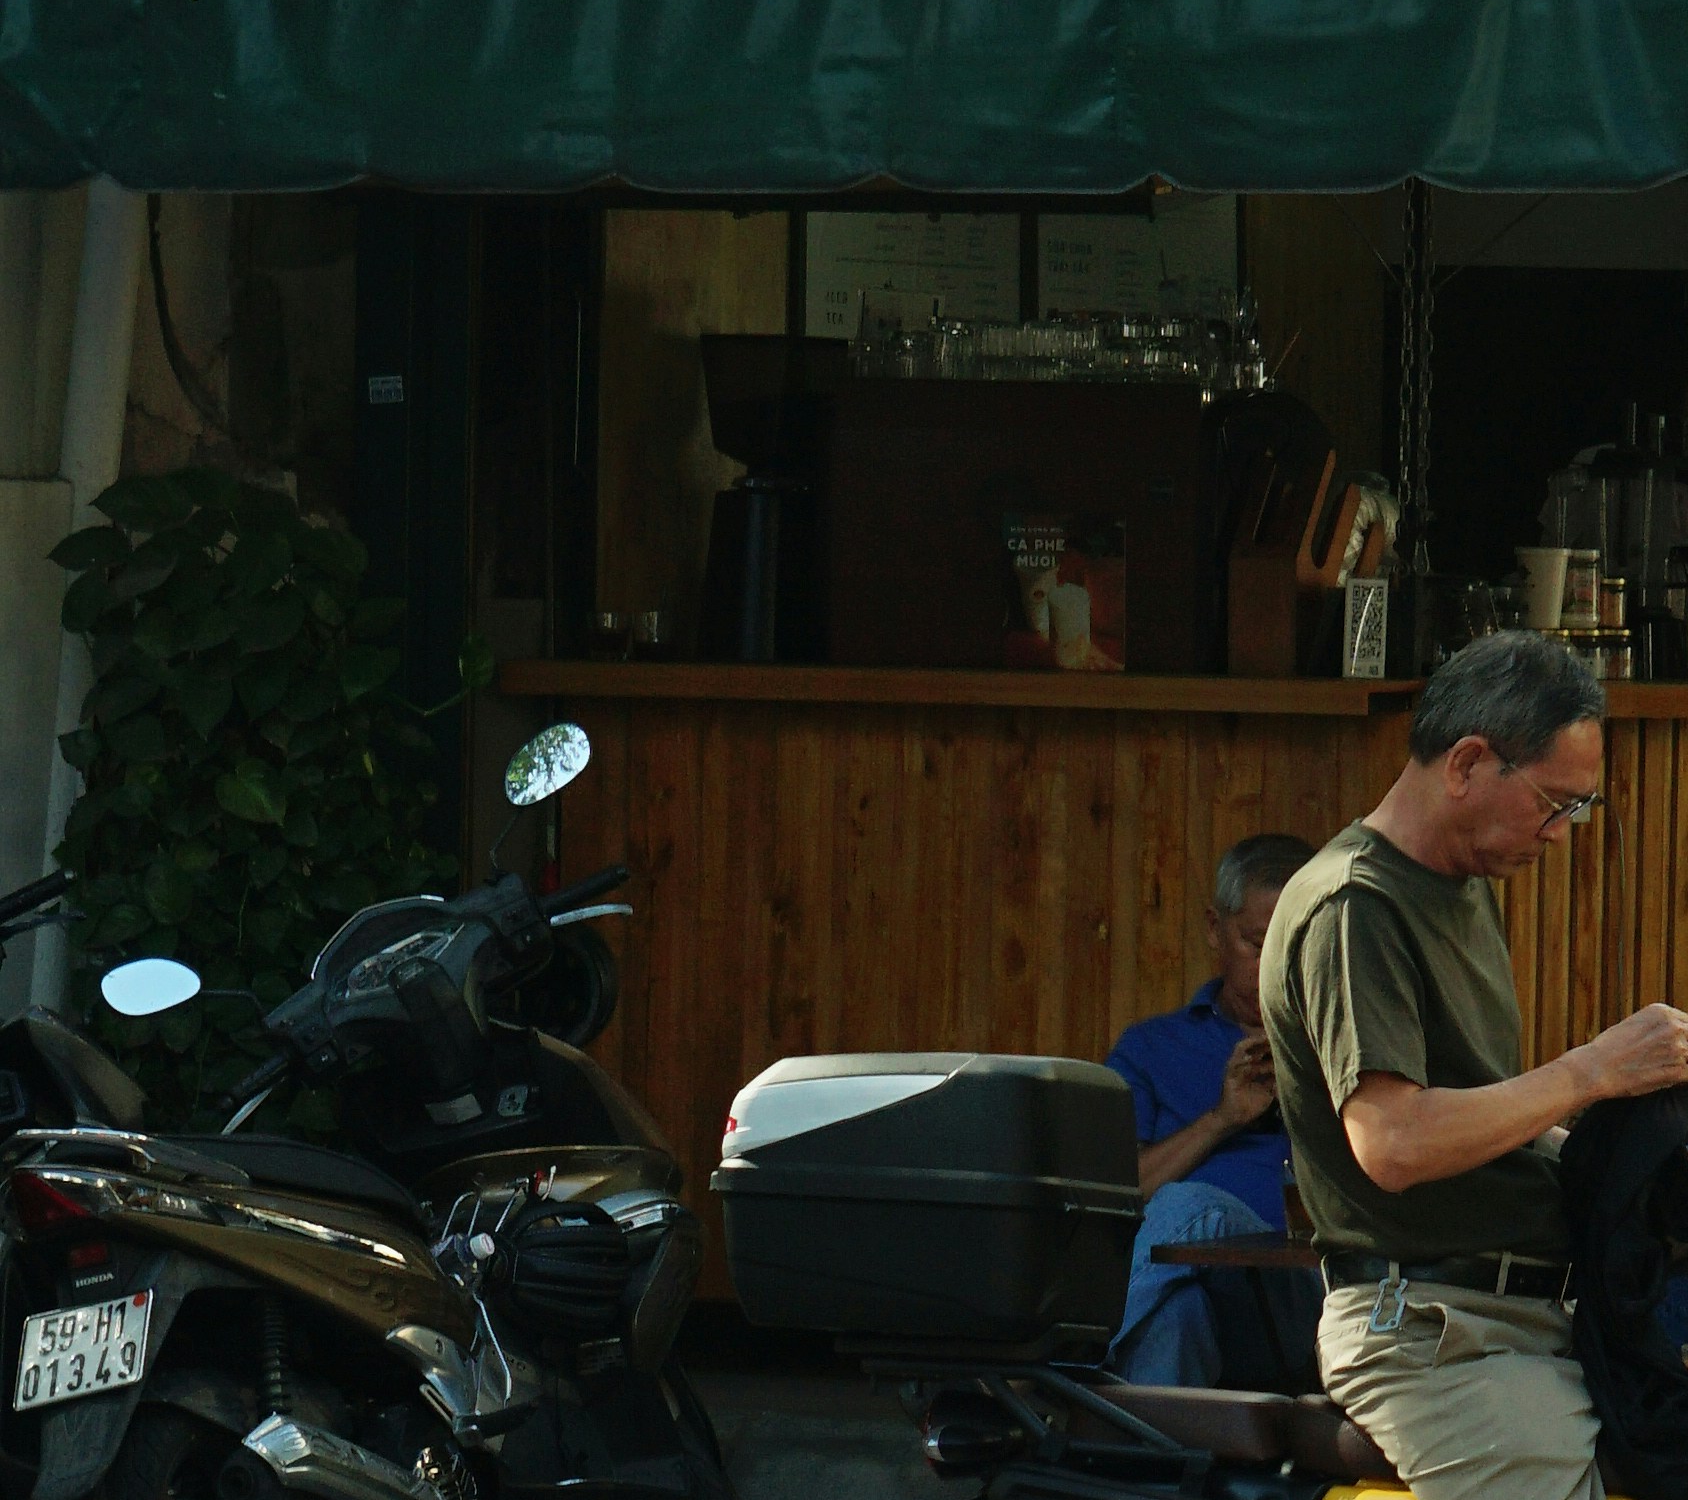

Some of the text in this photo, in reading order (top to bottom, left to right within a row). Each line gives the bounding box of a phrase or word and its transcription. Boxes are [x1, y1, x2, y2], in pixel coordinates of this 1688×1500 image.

[75, 1272, 115, 1288] HONDA
[40, 1301, 127, 1356] 59-H1
[23, 1341, 136, 1401] 013.49
